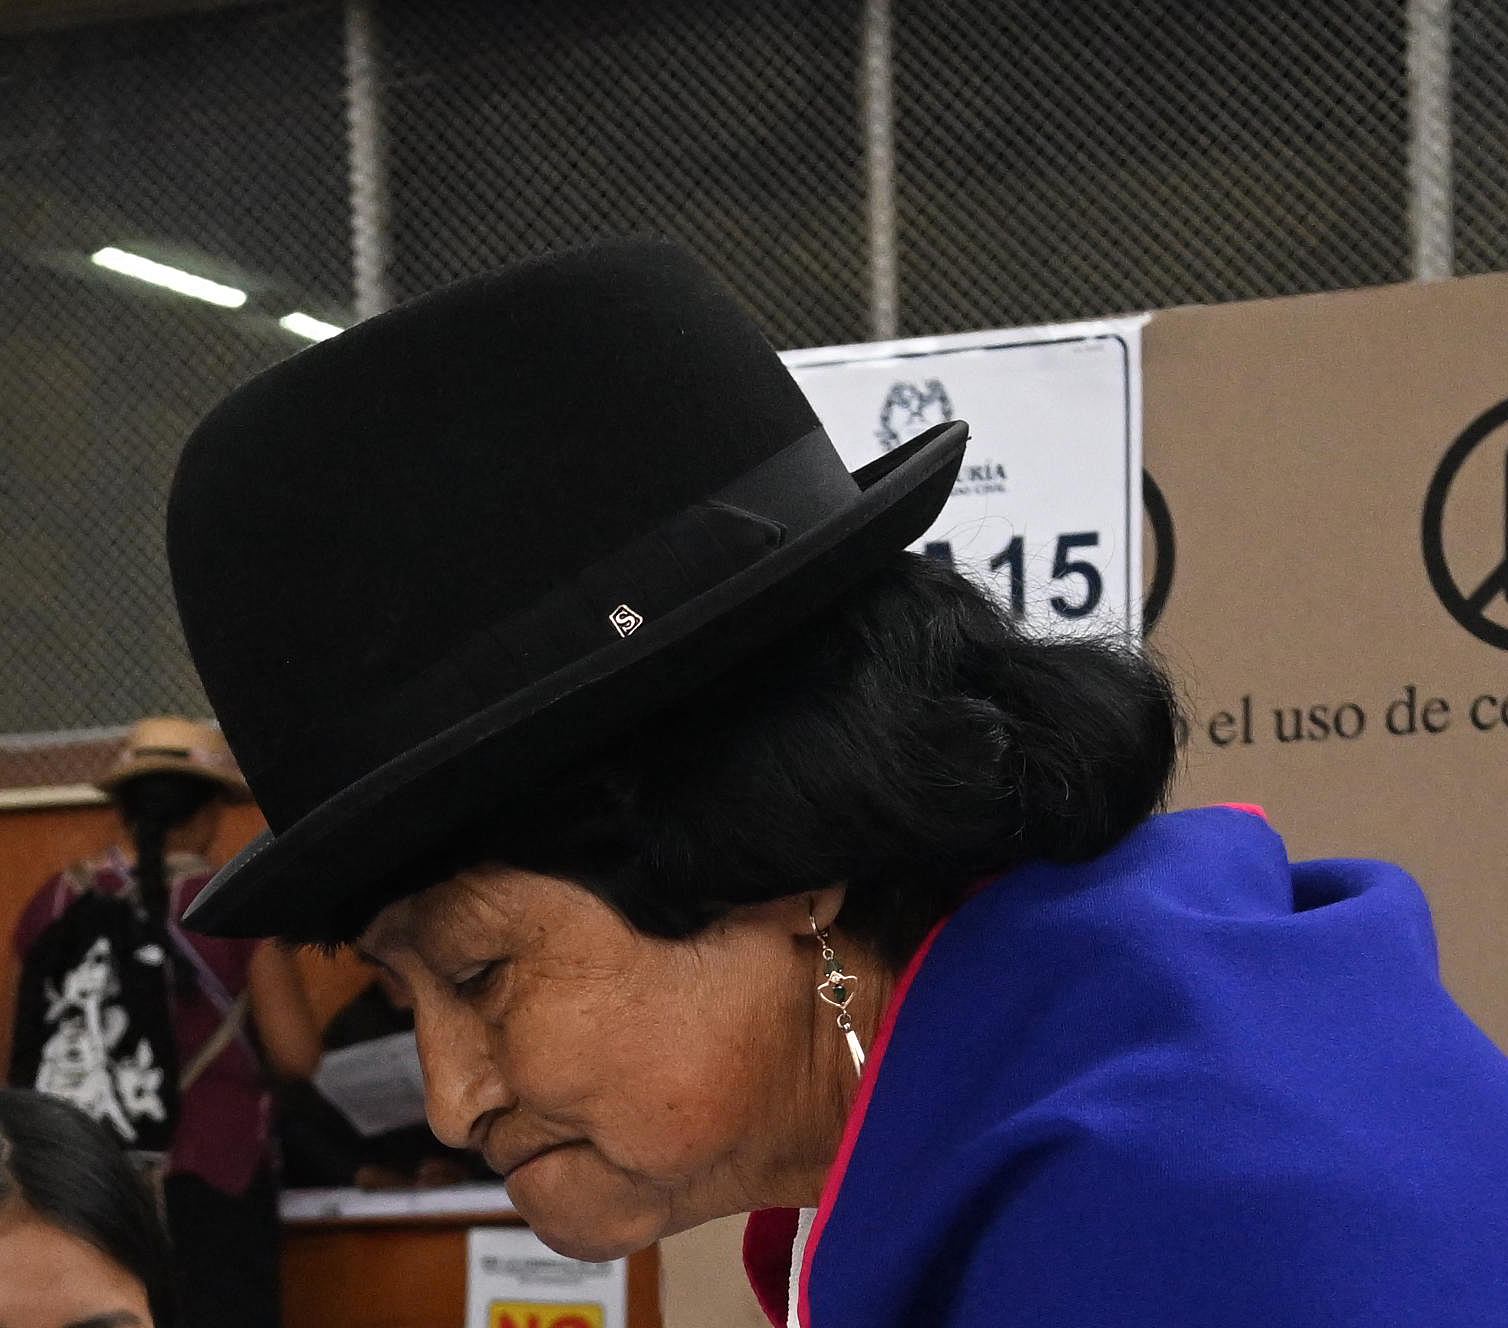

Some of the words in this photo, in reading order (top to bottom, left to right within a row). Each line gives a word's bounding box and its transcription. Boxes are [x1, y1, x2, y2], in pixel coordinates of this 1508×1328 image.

[990, 531, 1103, 620] 15
[1208, 695, 1255, 746] el
[1274, 700, 1366, 743] uso
[1385, 684, 1451, 735] de
